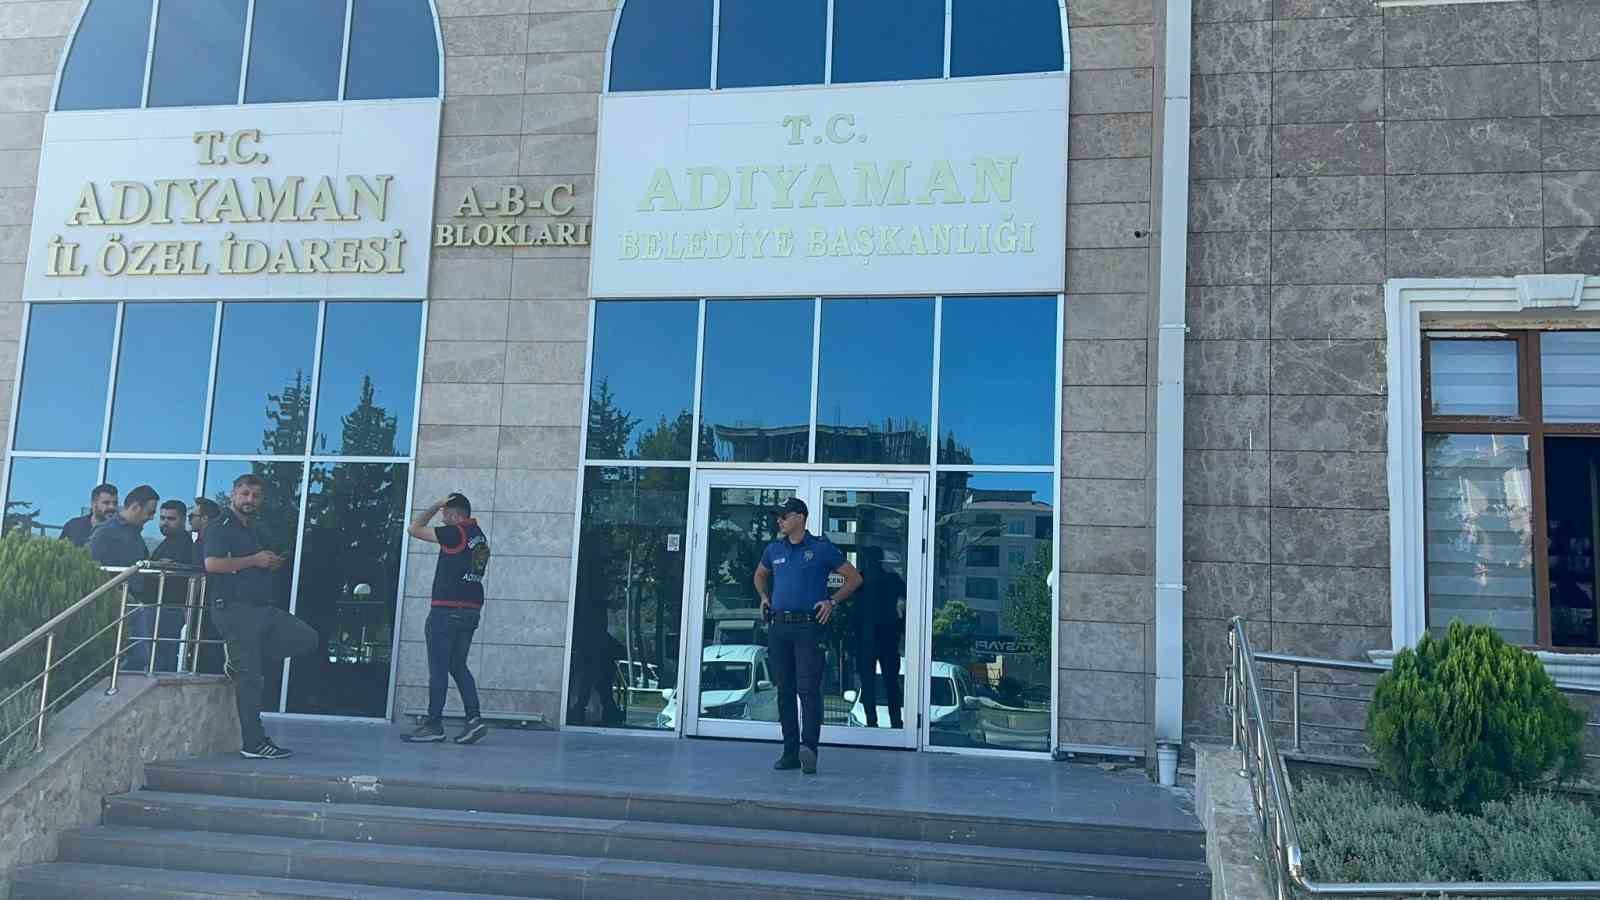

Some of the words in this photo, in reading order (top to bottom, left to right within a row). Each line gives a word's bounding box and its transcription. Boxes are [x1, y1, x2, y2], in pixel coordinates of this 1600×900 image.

[193, 128, 269, 166] T.C.
[782, 113, 868, 145] T.C.
[65, 174, 394, 226] ADIYAMAN
[454, 183, 576, 217] A-B-C
[636, 154, 1020, 212] ADIYAMAN
[45, 234, 88, 277] İL
[99, 232, 211, 277] ÖZEL
[218, 229, 407, 275] İDARESİ
[434, 222, 592, 247] BLOKLARI
[616, 222, 795, 261] BELEDİYE
[804, 210, 1036, 266] BAŞKANLIĞI
